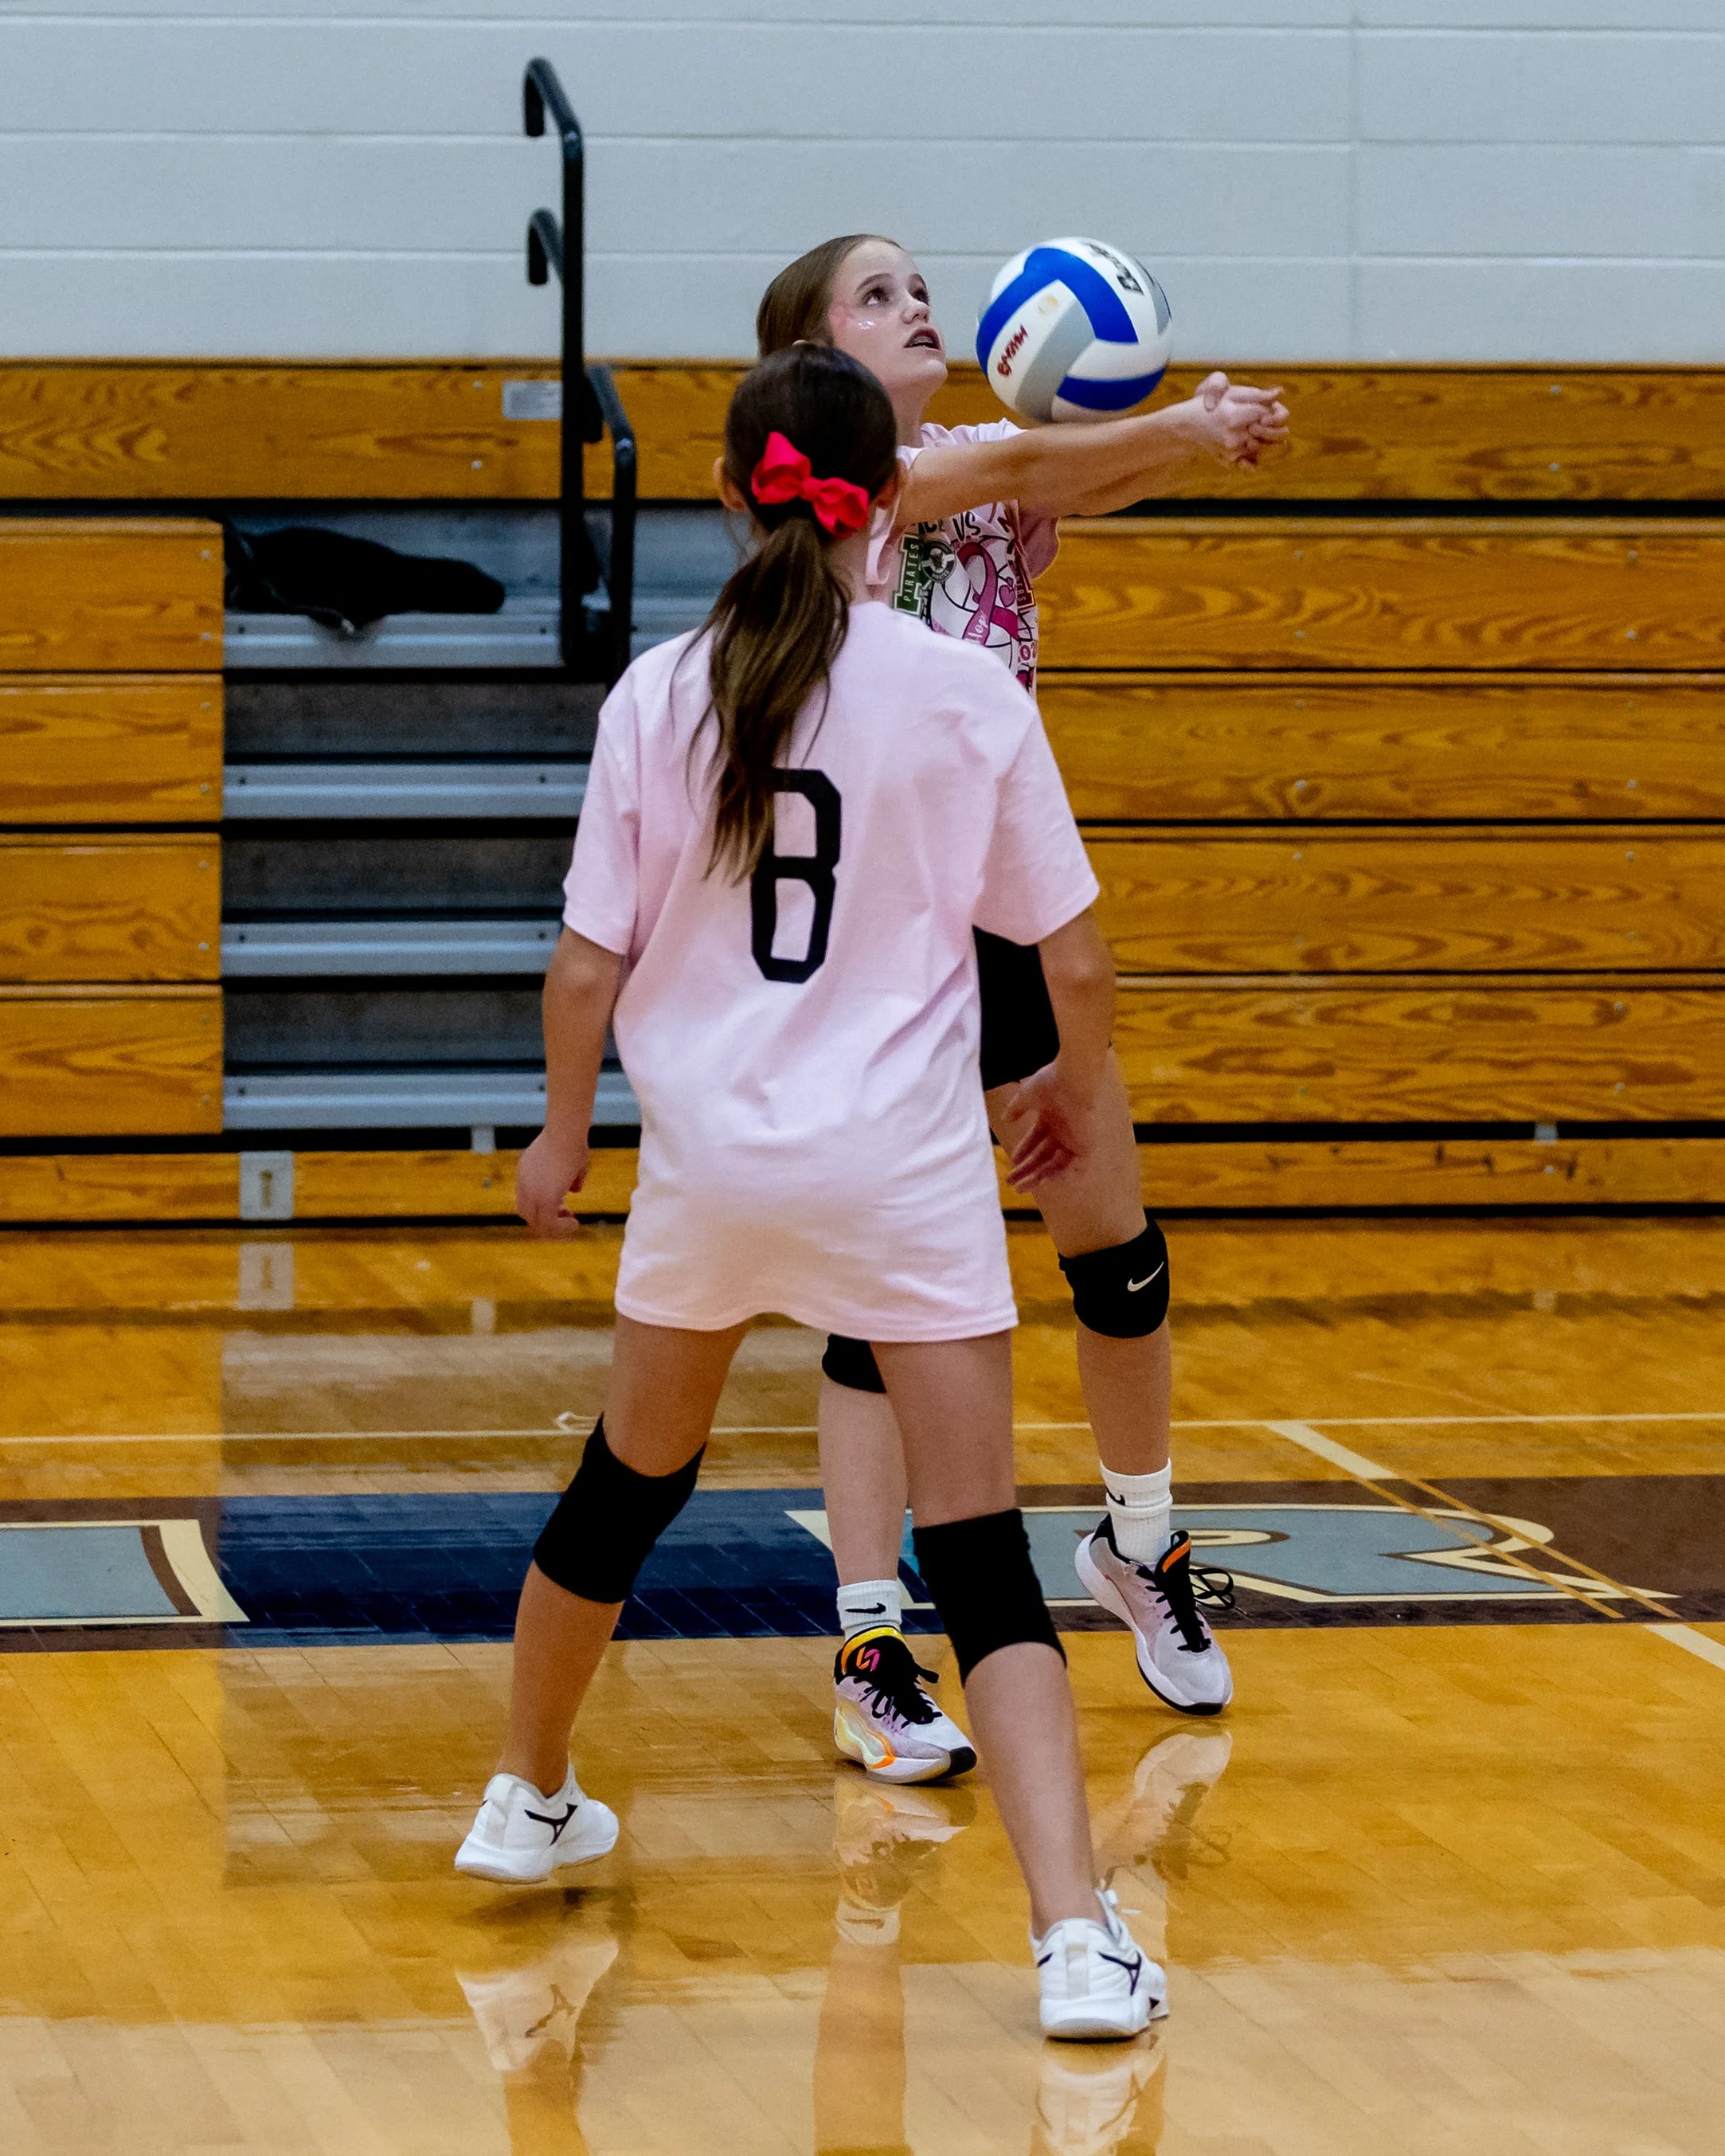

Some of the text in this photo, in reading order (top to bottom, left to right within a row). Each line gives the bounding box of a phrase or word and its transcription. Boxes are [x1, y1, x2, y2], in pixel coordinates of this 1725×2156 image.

[952, 511, 981, 541] VS
[903, 543, 920, 602] PIRATES
[751, 768, 842, 984] 8
